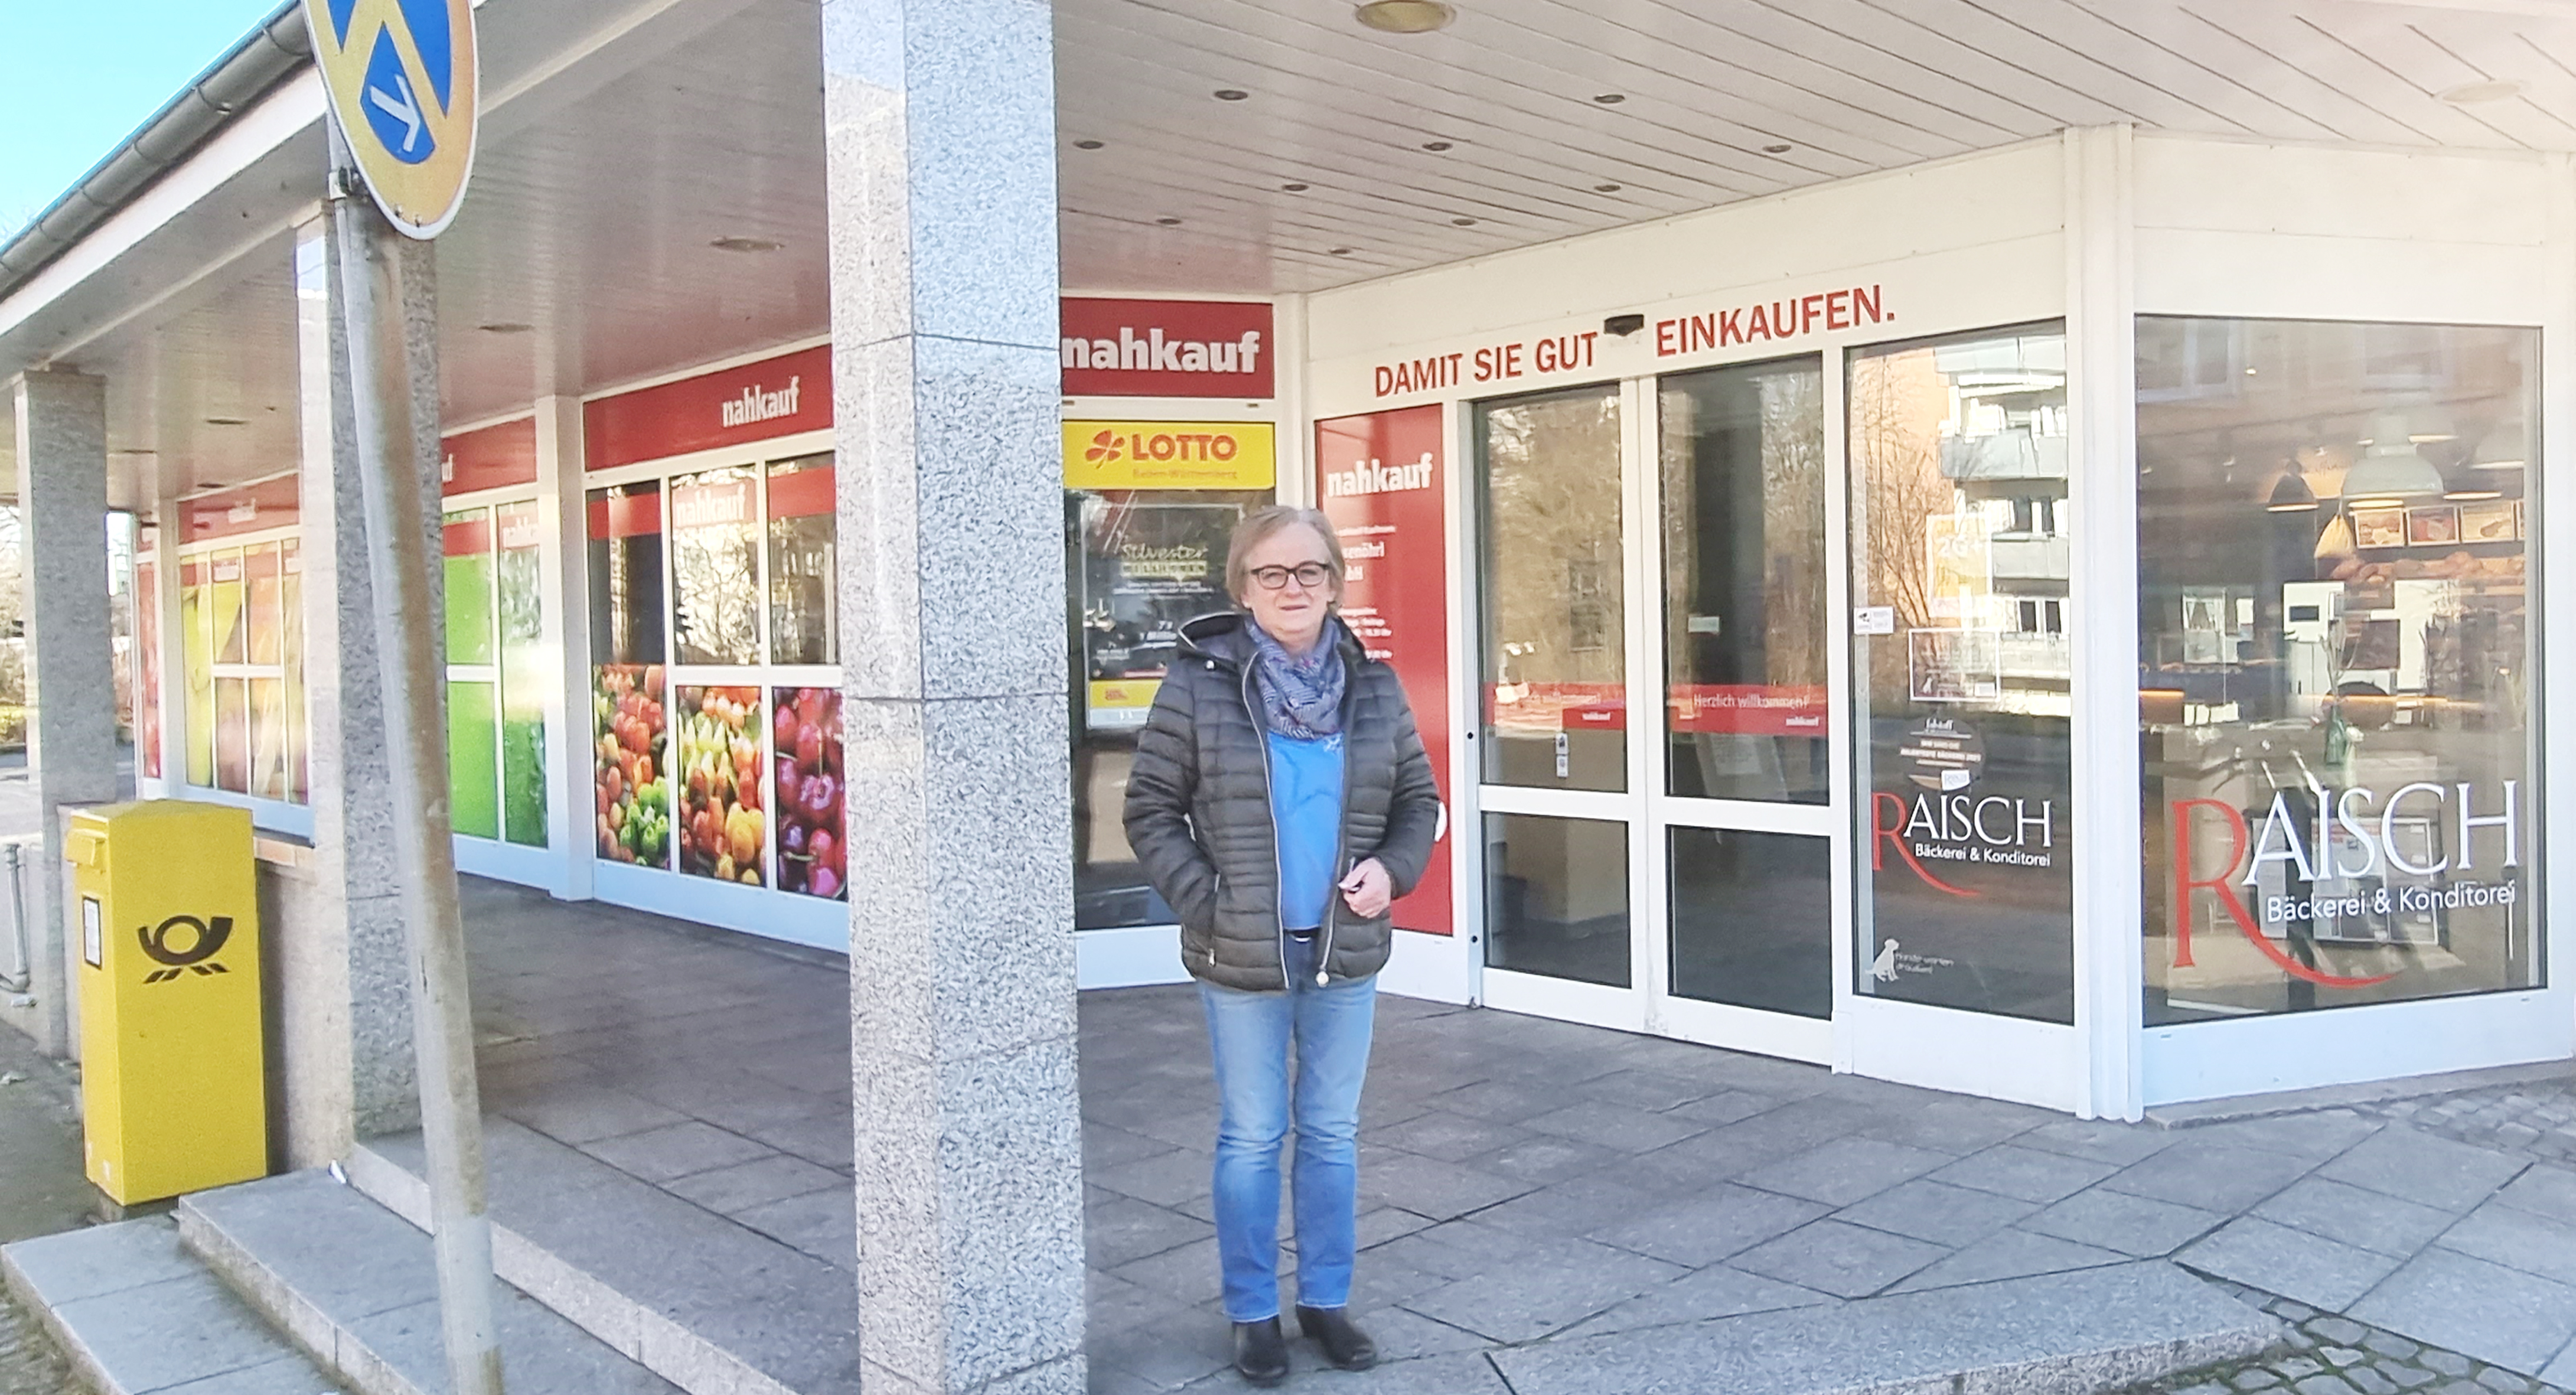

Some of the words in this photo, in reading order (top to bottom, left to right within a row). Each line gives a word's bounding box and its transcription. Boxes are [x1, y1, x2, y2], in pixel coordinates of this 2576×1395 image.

[1061, 327, 1260, 373] nahkauf
[1375, 353, 1463, 398] DAMIT
[1473, 343, 1522, 383] SIE
[1535, 331, 1597, 373] GUT
[1656, 285, 1895, 357] EINKAUFEN.
[723, 376, 800, 428] nahkauf
[1132, 434, 1238, 461] LOTTO
[1327, 452, 1433, 497] nahkauf
[676, 483, 745, 527] nahkauf
[1121, 542, 1208, 560] Silvester
[1693, 693, 1735, 708] Herzlich
[1737, 693, 1811, 712] willkommen!
[1872, 791, 2051, 896] RAISCH
[1915, 843, 1967, 861] Bäckerei
[1970, 848, 1980, 862] &
[1983, 848, 2051, 867] Konditorei
[2173, 780, 2518, 988] RAISCH
[2267, 891, 2366, 923] Bäckerei
[2374, 887, 2392, 914] &
[2399, 878, 2516, 912] Konditorei
